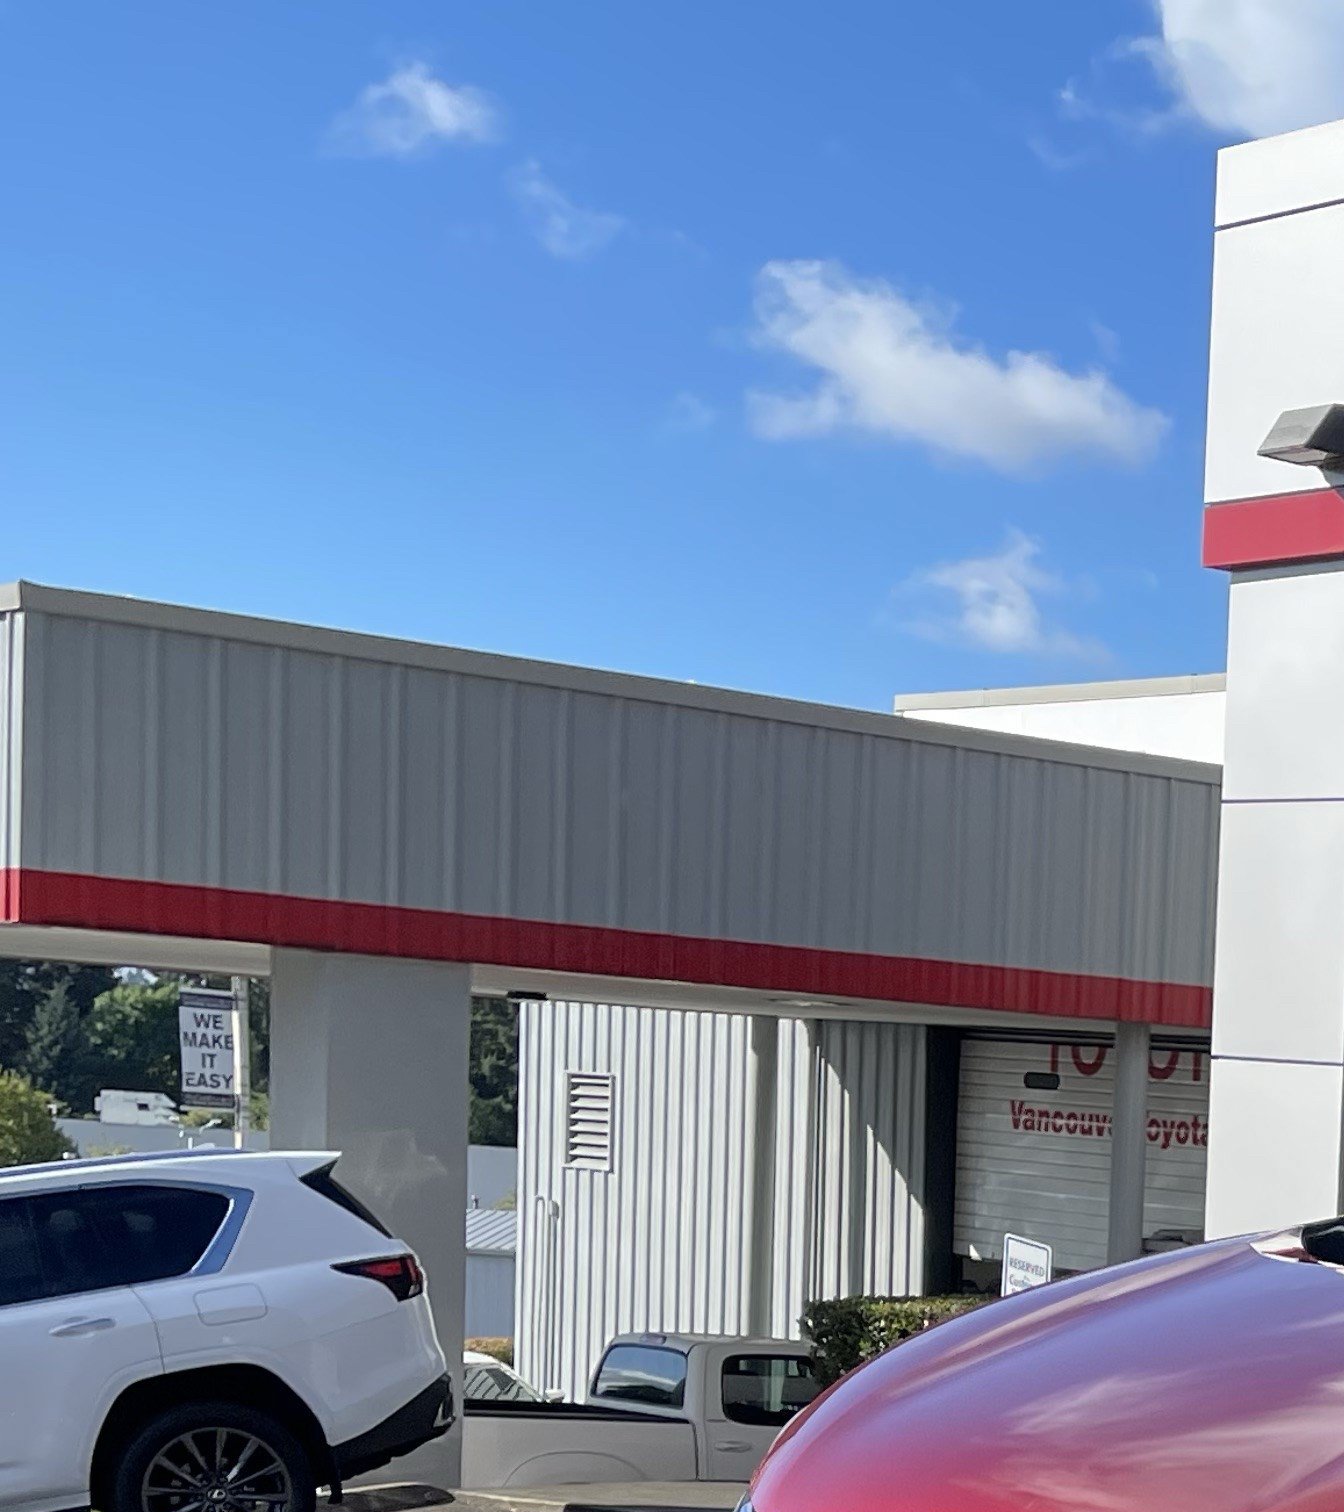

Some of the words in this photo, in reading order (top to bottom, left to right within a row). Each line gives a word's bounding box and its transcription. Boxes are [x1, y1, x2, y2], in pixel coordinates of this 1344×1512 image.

[193, 1012, 224, 1030] WE
[183, 1031, 233, 1050] MAKE
[201, 1053, 217, 1068] IT
[185, 1072, 233, 1089] EASY
[1009, 1100, 1113, 1137] Vancouv
[1146, 1111, 1208, 1149] oyota
[1009, 1257, 1045, 1277] RESERVED
